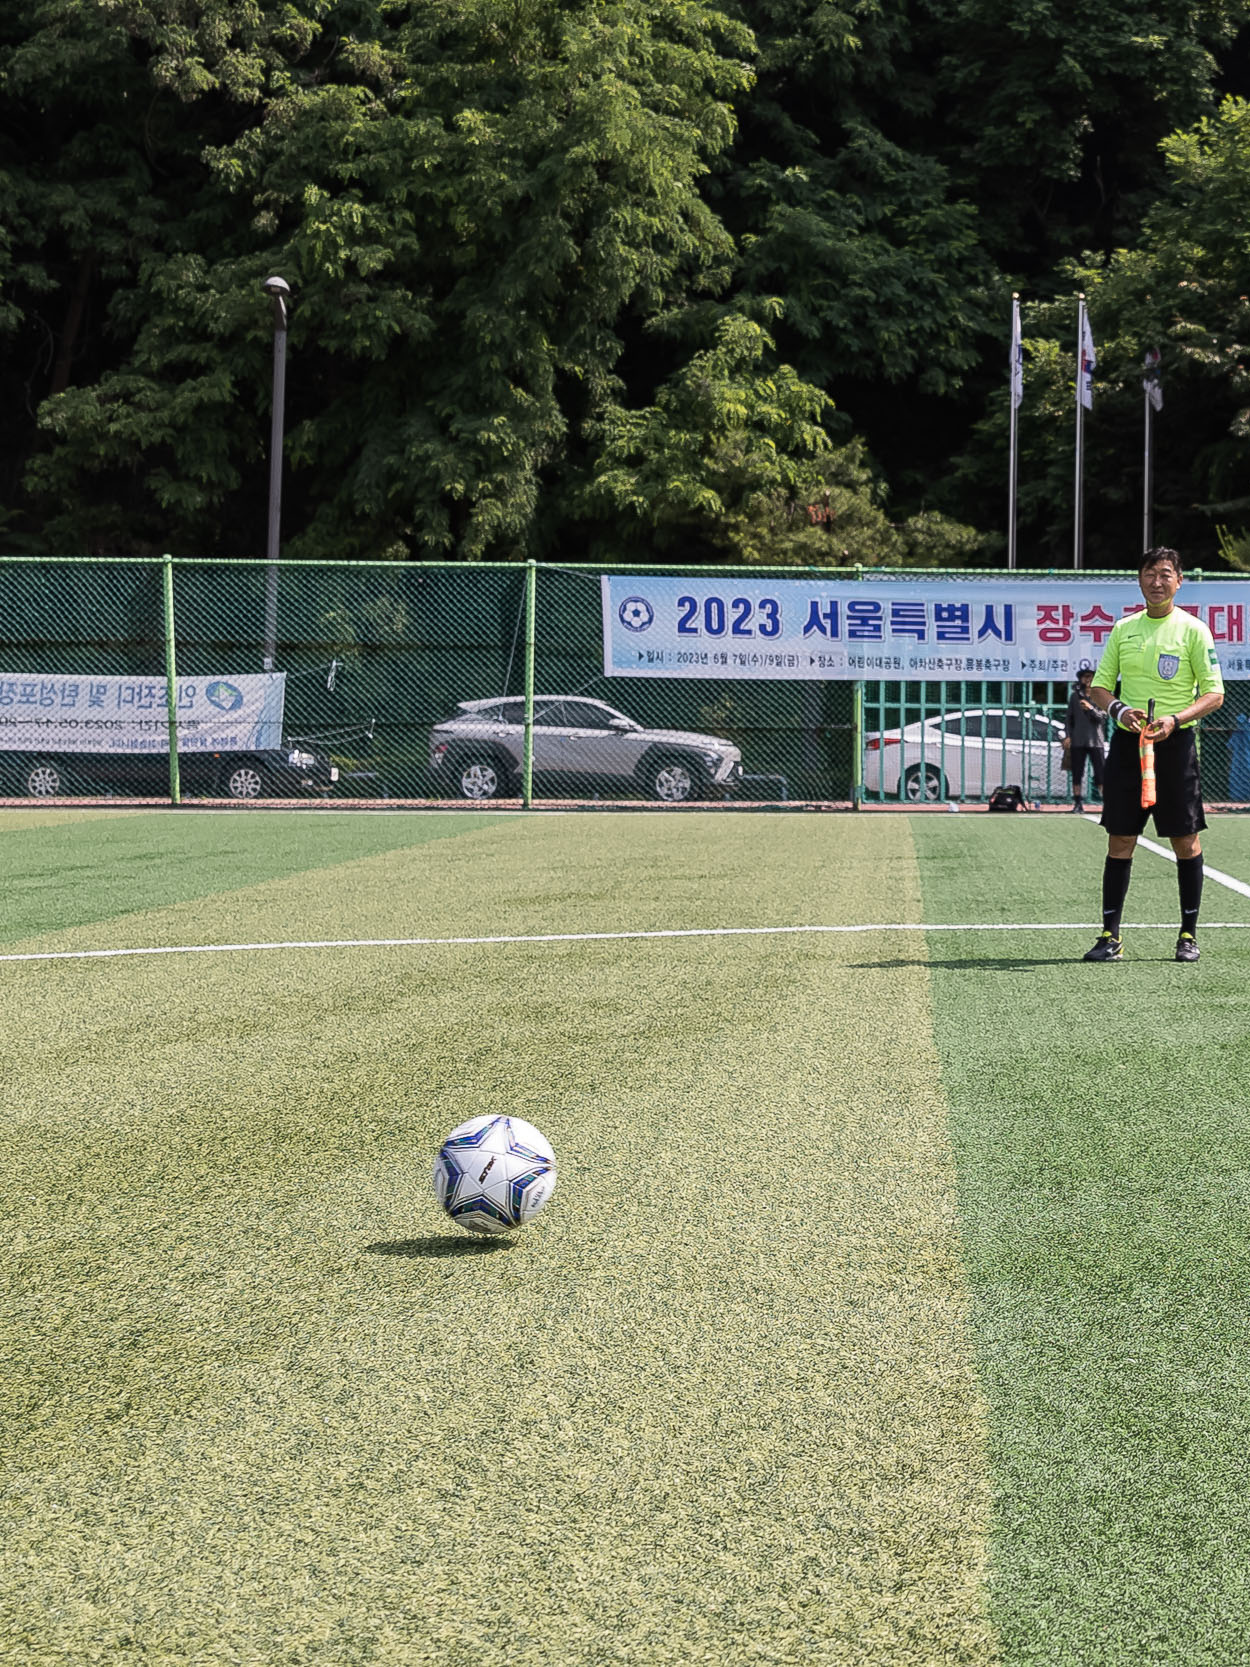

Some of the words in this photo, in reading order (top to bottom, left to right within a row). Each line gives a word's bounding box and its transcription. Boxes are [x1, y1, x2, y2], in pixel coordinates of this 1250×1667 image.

[677, 595, 781, 637] 2023
[803, 599, 1013, 642] 서울특별시
[646, 650, 664, 664] 일시
[677, 651, 709, 665] 2023년
[713, 652, 728, 666] 6월
[817, 655, 835, 668] 장소
